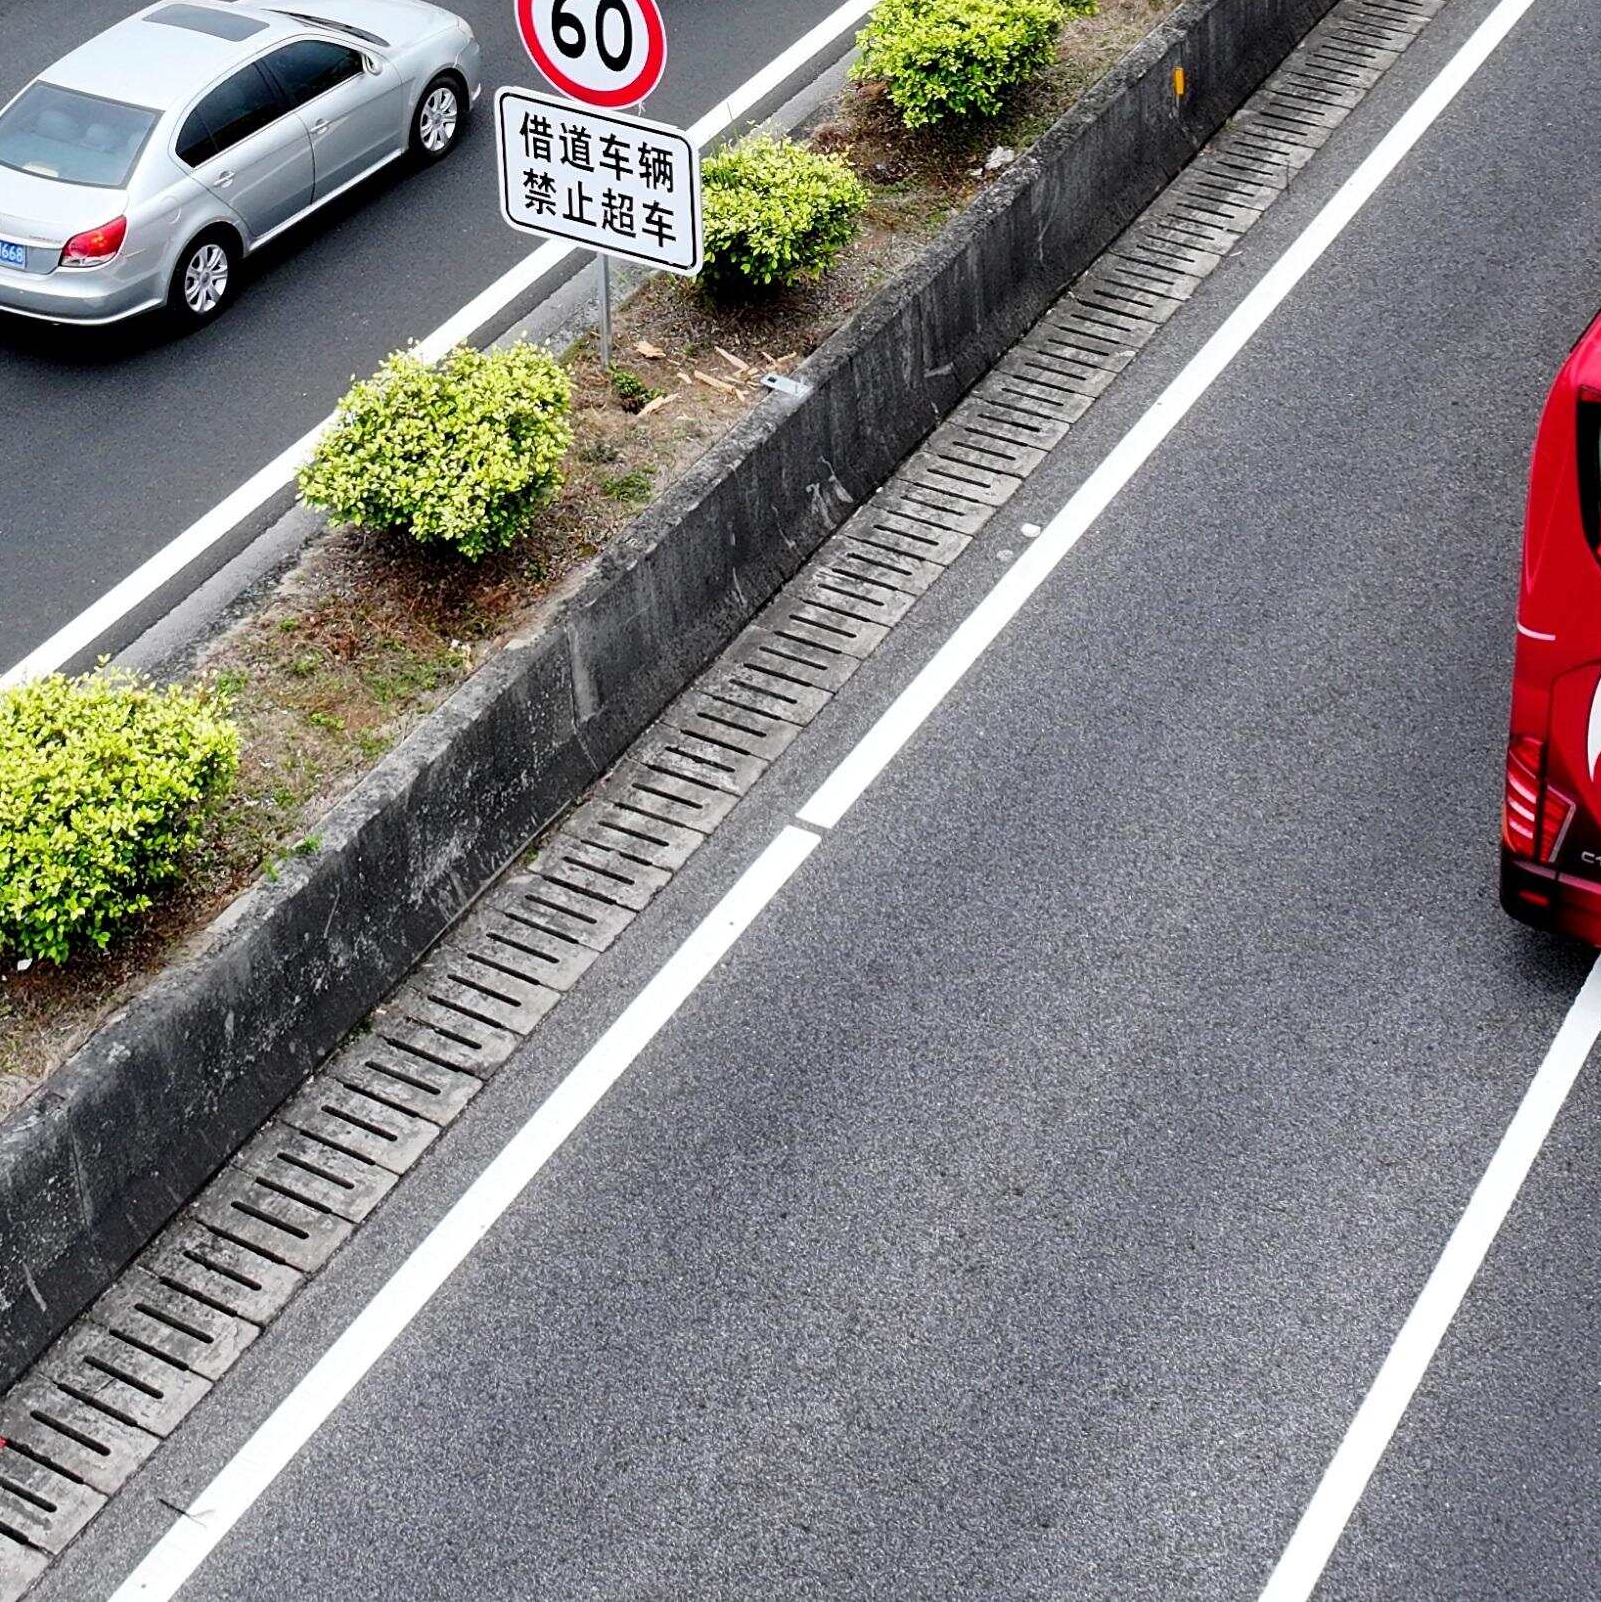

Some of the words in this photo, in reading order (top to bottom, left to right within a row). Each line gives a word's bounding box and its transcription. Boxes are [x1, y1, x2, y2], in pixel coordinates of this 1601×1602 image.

[519, 111, 674, 194] 借道车辆
[522, 168, 677, 248] 禁止超车
